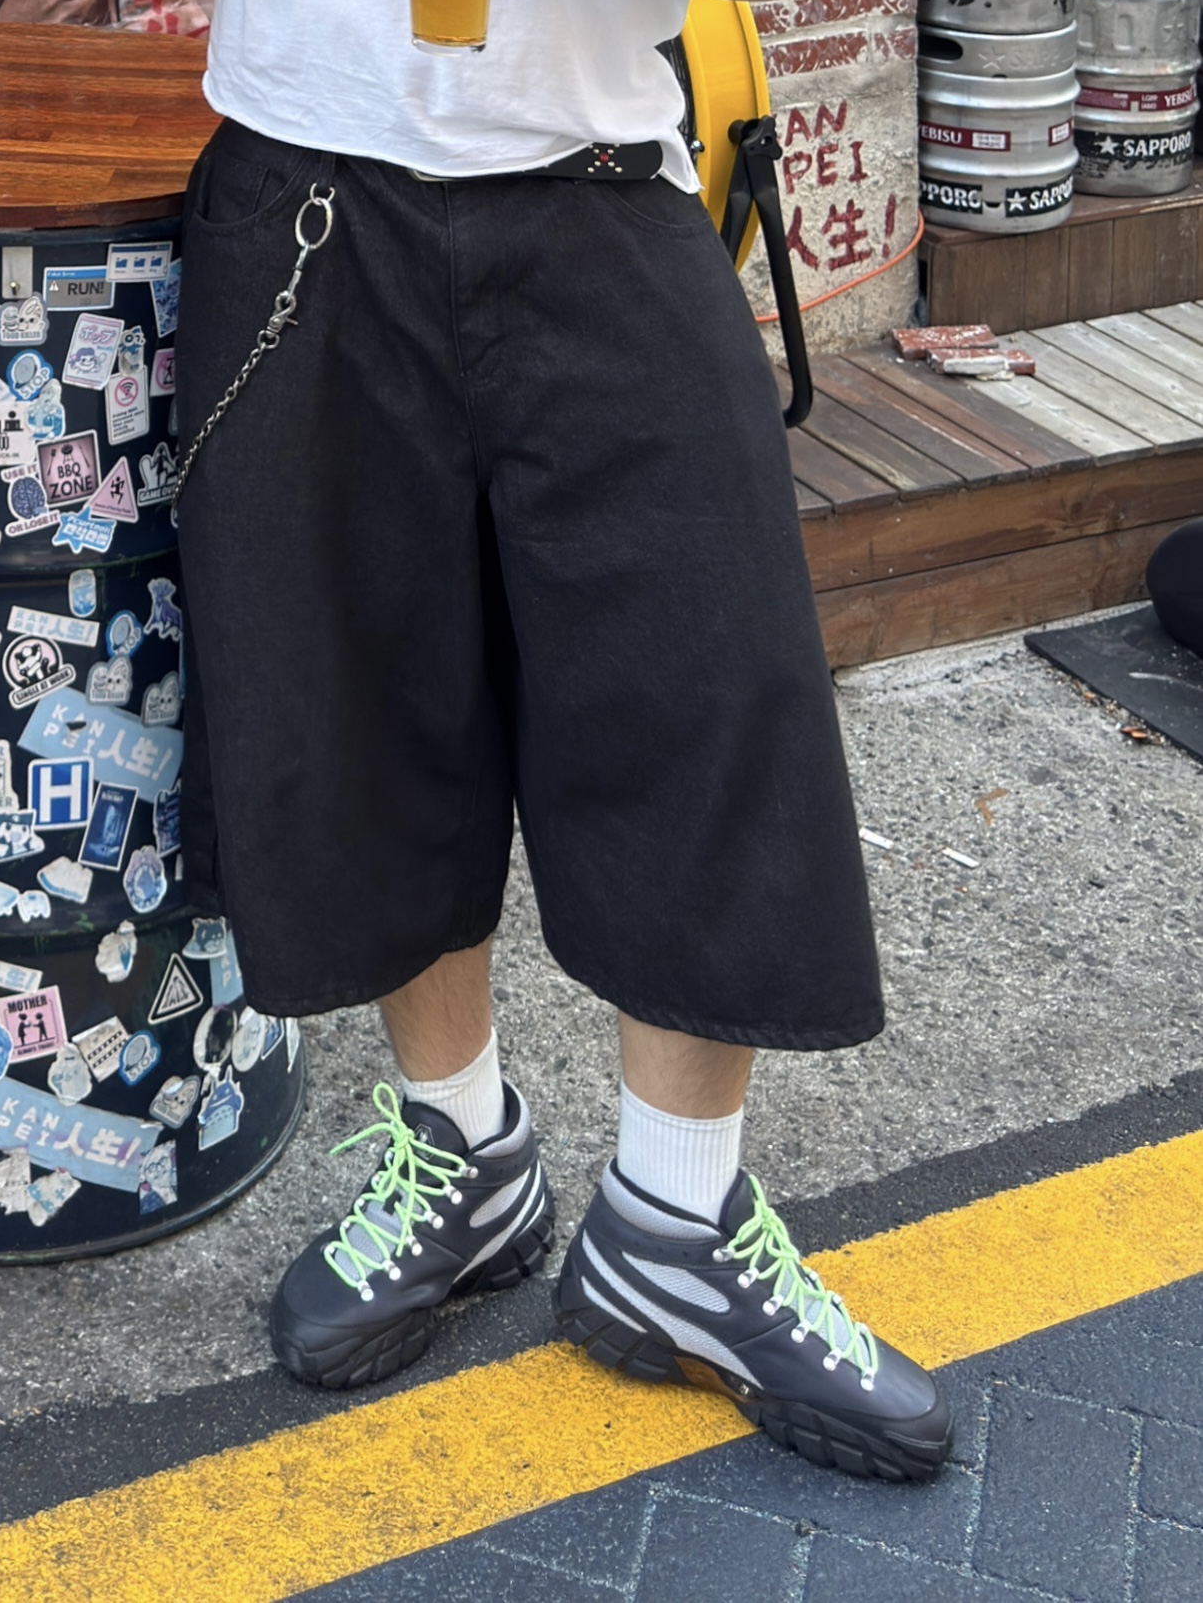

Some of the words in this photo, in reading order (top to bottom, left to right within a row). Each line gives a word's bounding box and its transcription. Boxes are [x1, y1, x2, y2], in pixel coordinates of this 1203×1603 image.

[774, 99, 848, 147] AN
[1122, 130, 1192, 157] SAPPORO
[783, 141, 869, 195] PEI
[67, 281, 104, 295] RUN!
[19, 366, 51, 399] STOP
[3, 469, 23, 480] USE
[57, 462, 81, 478] BBQ
[49, 475, 93, 499] ZONE
[8, 522, 24, 535] OR
[25, 515, 49, 530] LOSE
[50, 512, 59, 523] IT
[98, 728, 174, 781] 人生!
[39, 764, 83, 823] H
[7, 994, 48, 1014] MOTHER
[129, 1047, 158, 1080] STOP
[2, 1097, 60, 1131] KAN
[53, 1120, 141, 1169] 人生!
